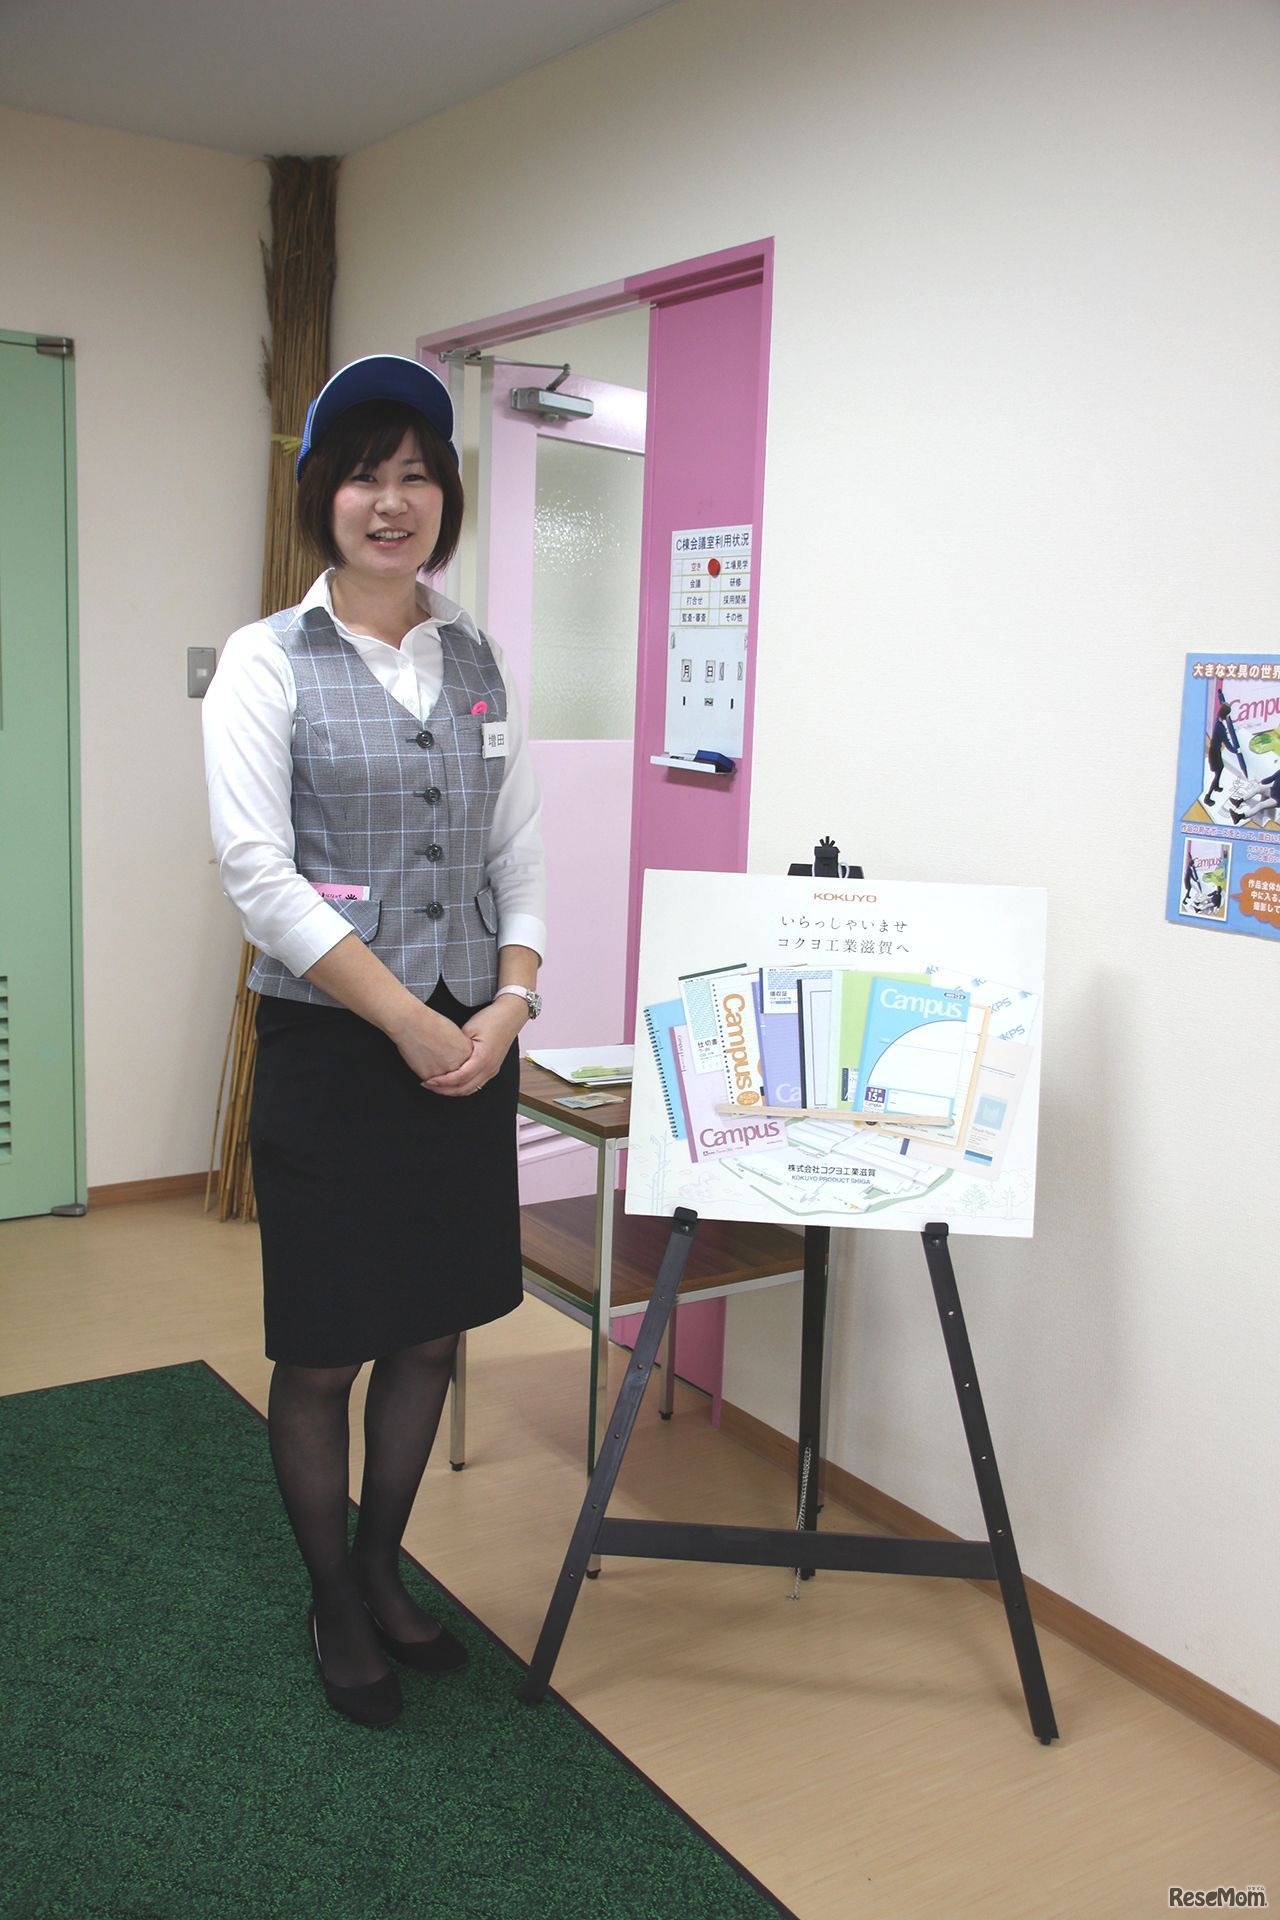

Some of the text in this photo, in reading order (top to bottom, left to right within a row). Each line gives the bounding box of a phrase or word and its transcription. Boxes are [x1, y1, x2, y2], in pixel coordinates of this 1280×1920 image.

[675, 532, 749, 551] C棟会議室利用状況
[725, 560, 748, 570] 工場見学
[690, 579, 701, 589] 会議
[729, 578, 741, 587] 研修
[686, 596, 703, 606] 打合せ
[726, 613, 742, 622] その他
[1193, 664, 1280, 679] 大きな文具の世界
[813, 892, 877, 903] KOKUYO
[781, 915, 908, 933] いらっしゃいませ
[778, 937, 910, 955] コクヨ工業滋賀へ
[879, 986, 963, 1019] Campus
[1000, 1024, 1026, 1041] KPS
[722, 993, 752, 1090] Campus
[699, 1121, 780, 1147] Campus
[788, 1164, 876, 1177] 株式会社コクヨ工業滋賀
[818, 1176, 850, 1184] PRODUCT
